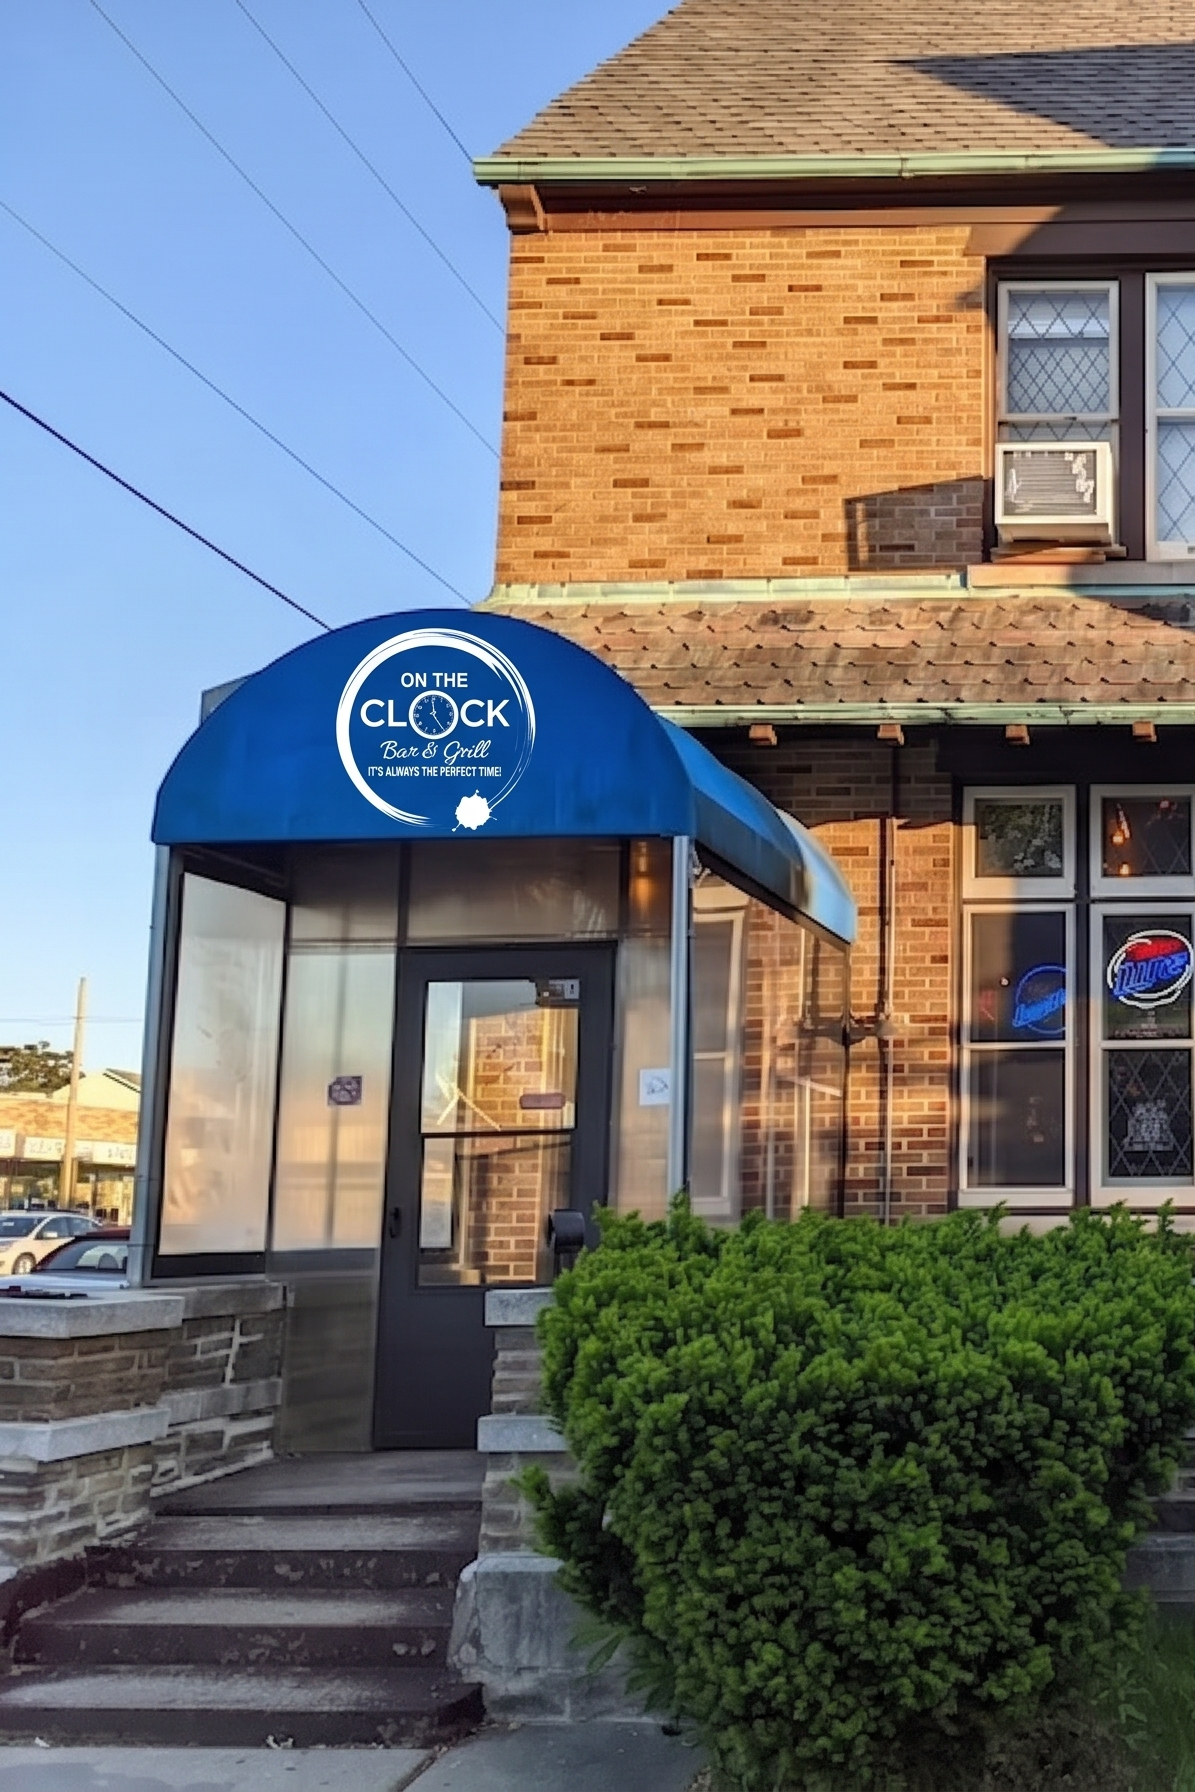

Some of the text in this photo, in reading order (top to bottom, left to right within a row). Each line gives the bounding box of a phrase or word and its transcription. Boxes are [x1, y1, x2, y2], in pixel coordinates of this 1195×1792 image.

[400, 672, 469, 688] ON THE
[360, 690, 511, 740] CLOCK
[379, 739, 492, 766] Bar & Grill
[367, 766, 502, 777] IT'S ALWAYS THE PERFECT TIME!
